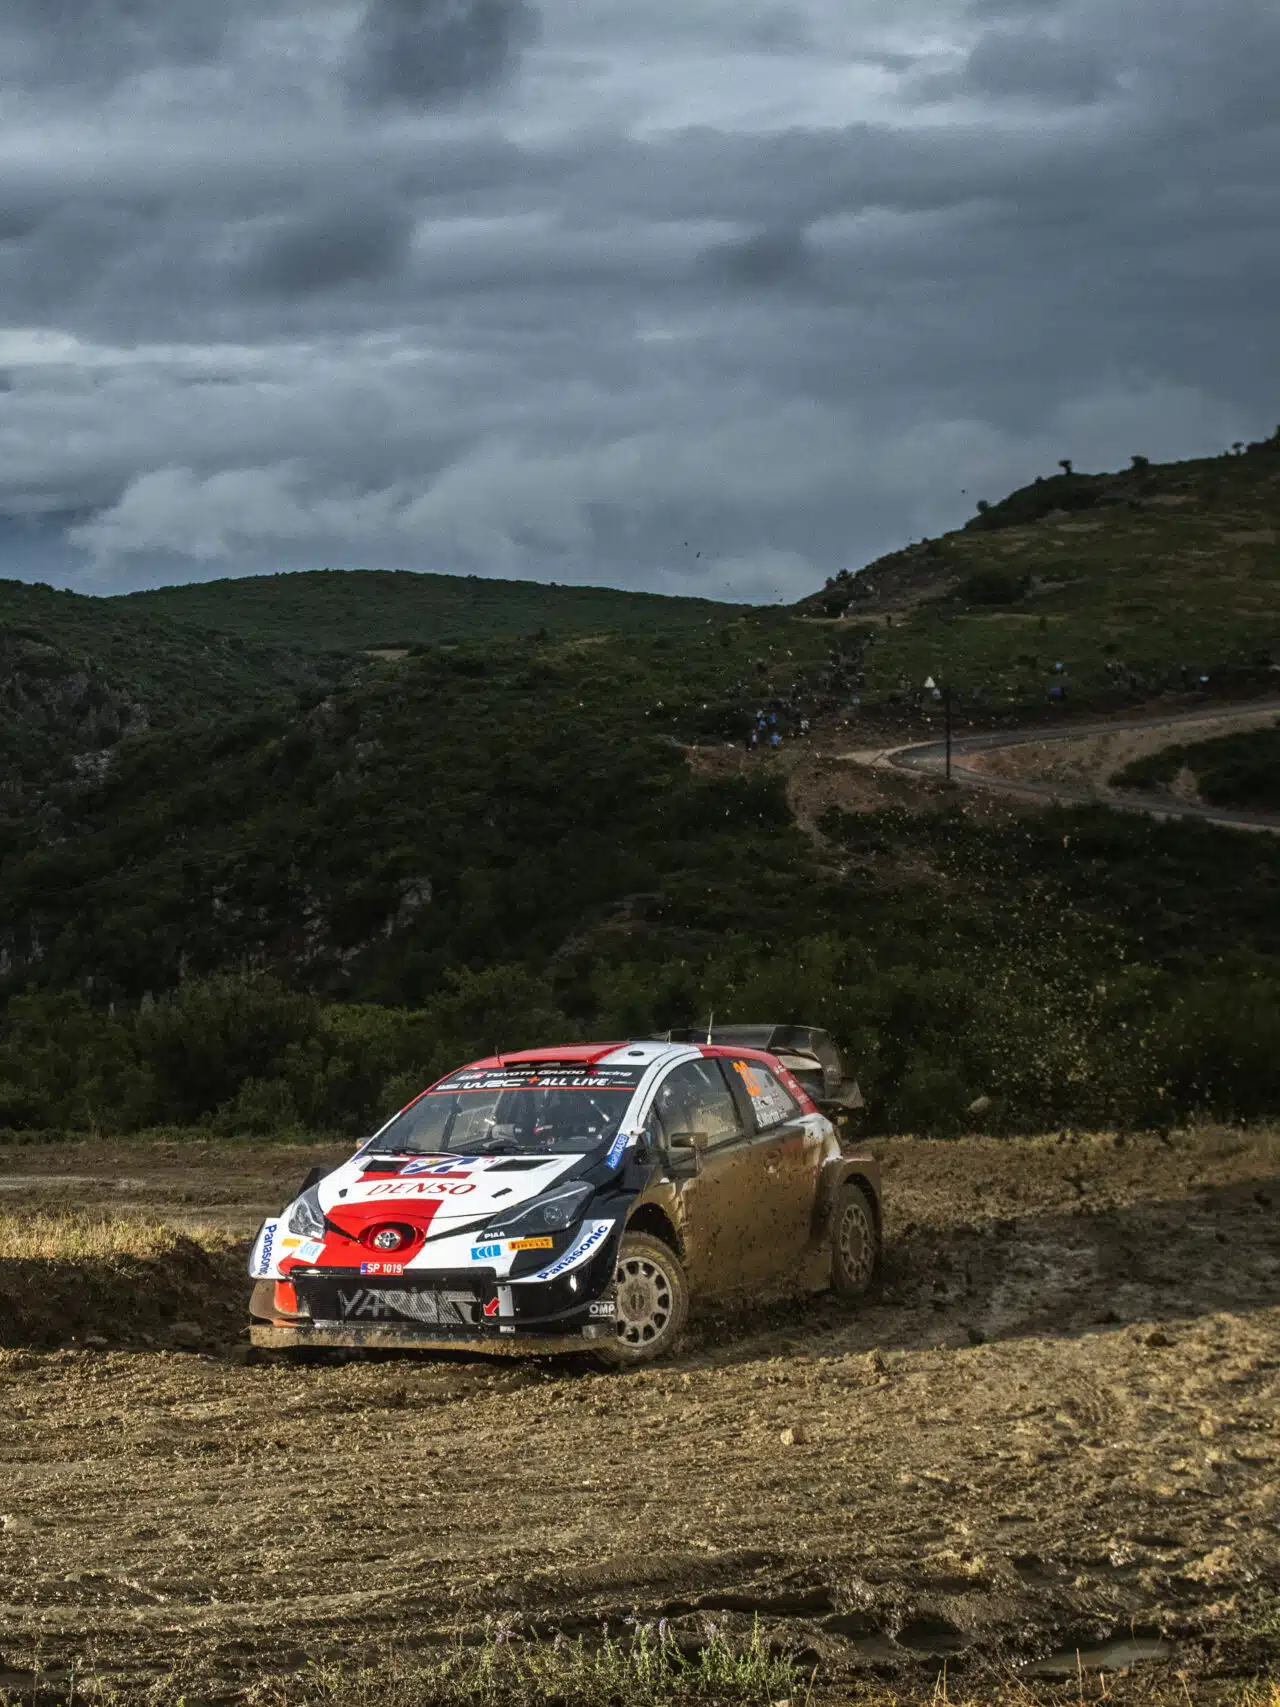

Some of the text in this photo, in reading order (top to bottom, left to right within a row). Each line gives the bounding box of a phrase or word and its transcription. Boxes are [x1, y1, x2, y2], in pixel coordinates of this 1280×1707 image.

[538, 1077, 567, 1086] ALL
[572, 1077, 609, 1086] LIVE
[366, 1182, 477, 1196] DENSO
[484, 1231, 505, 1239] PIAA
[258, 1224, 277, 1275] Panasonic
[537, 1225, 608, 1279] Panasonic
[366, 1263, 402, 1273] SP 1019
[589, 1303, 615, 1315] OMP
